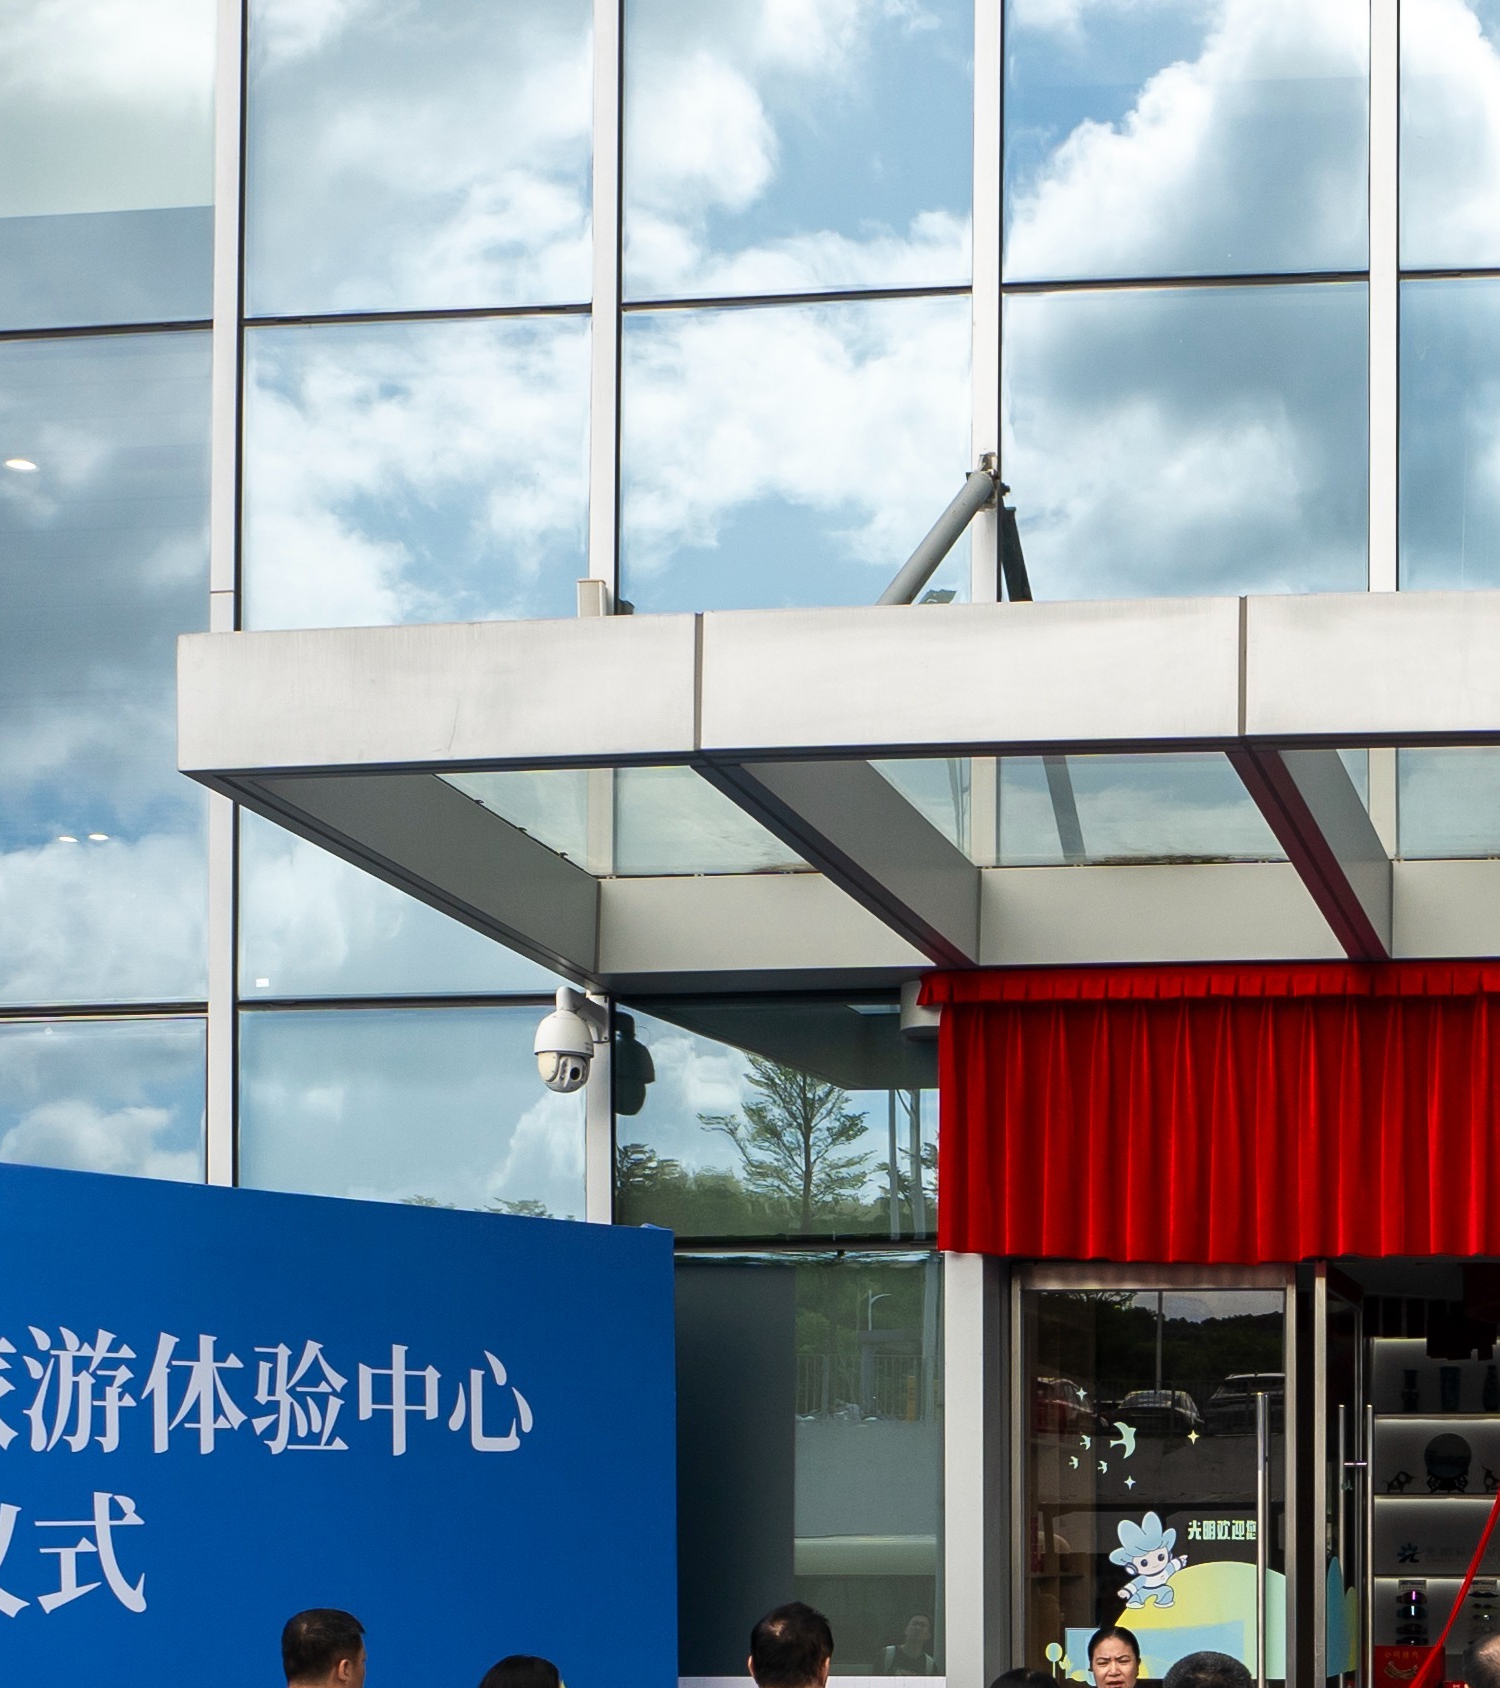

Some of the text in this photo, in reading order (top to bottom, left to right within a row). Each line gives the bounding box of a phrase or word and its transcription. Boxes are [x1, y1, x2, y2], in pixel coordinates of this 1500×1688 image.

[1187, 1519, 1257, 1541] 光明欢迎您
